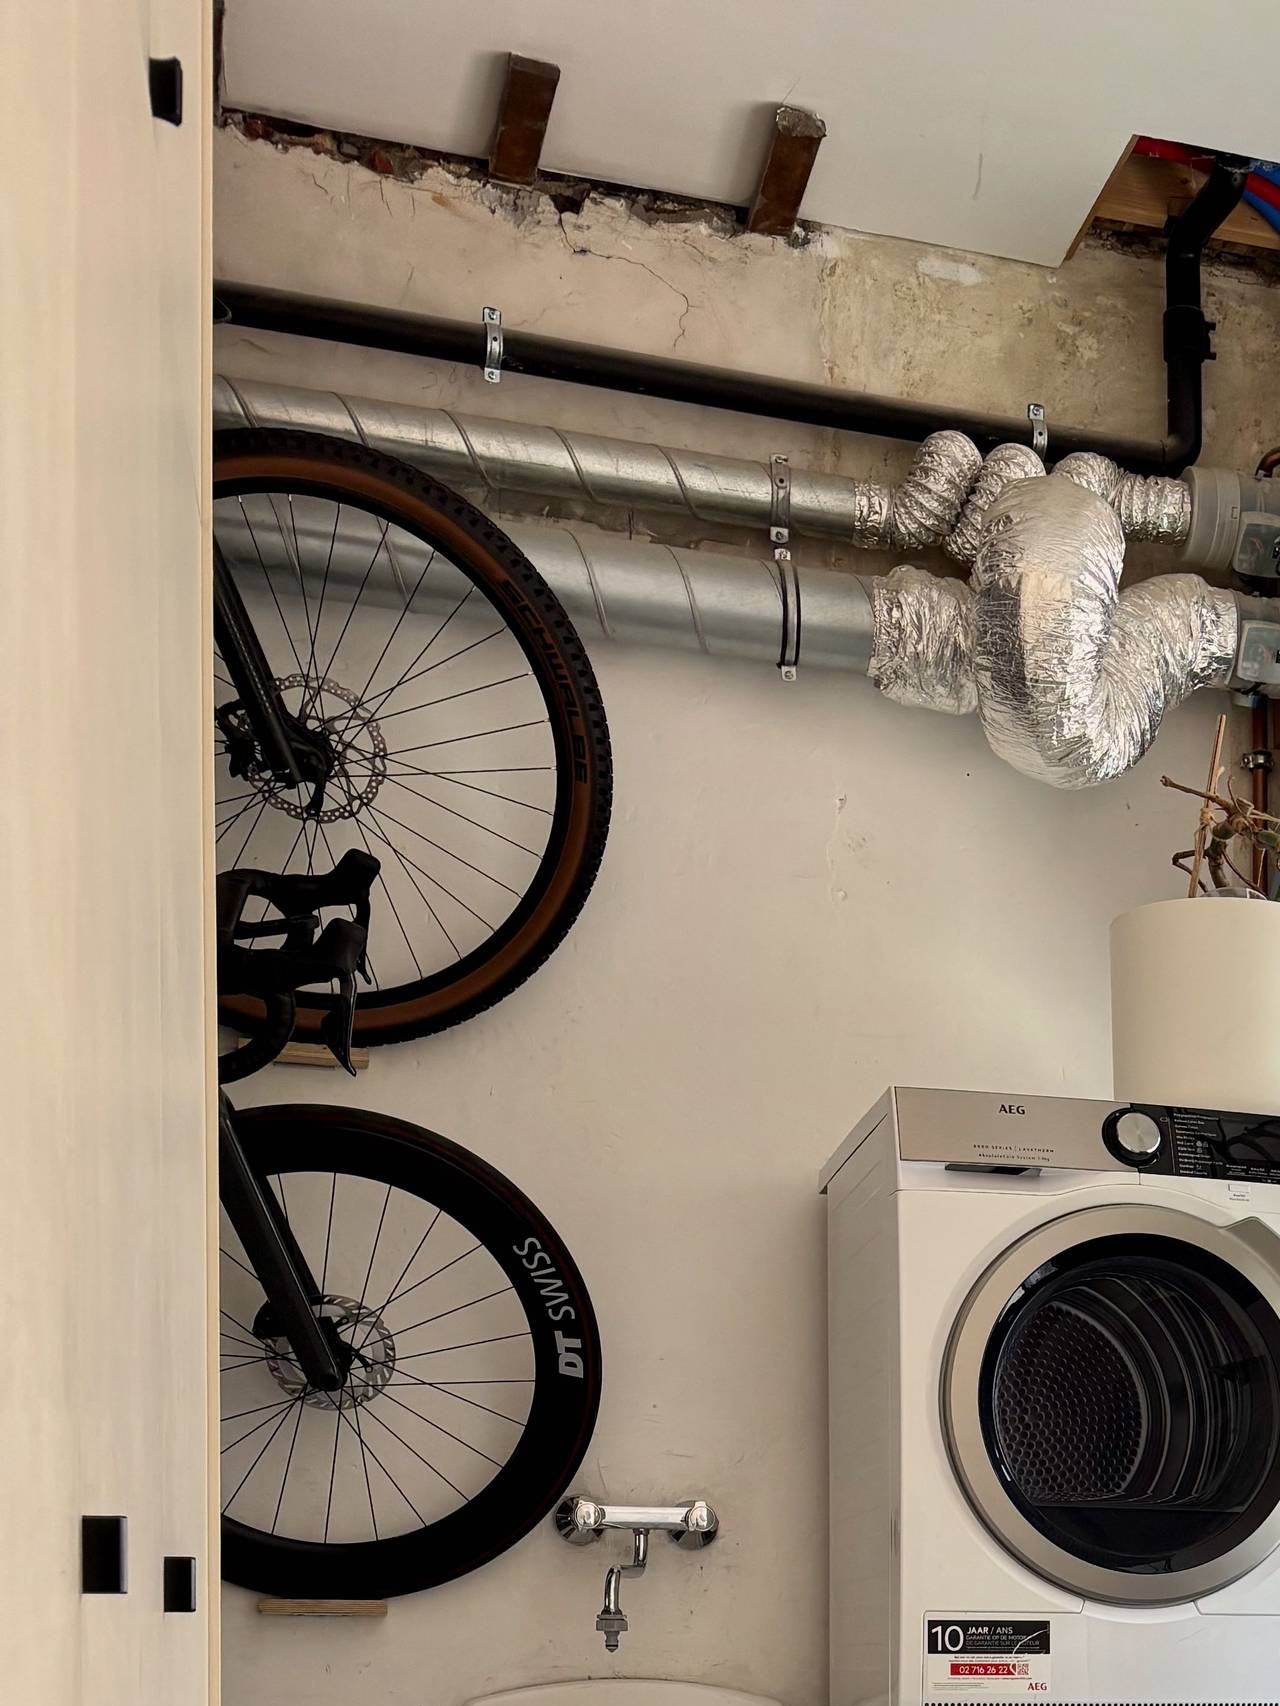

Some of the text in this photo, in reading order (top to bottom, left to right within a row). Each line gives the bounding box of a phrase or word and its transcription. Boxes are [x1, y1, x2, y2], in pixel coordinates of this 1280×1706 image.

[503, 580, 588, 784] SCHWALBE
[998, 1104, 1026, 1114] AEG
[512, 1237, 584, 1378] DT SWISS
[932, 1625, 964, 1652] 10
[1027, 1683, 1047, 1691] AEG
